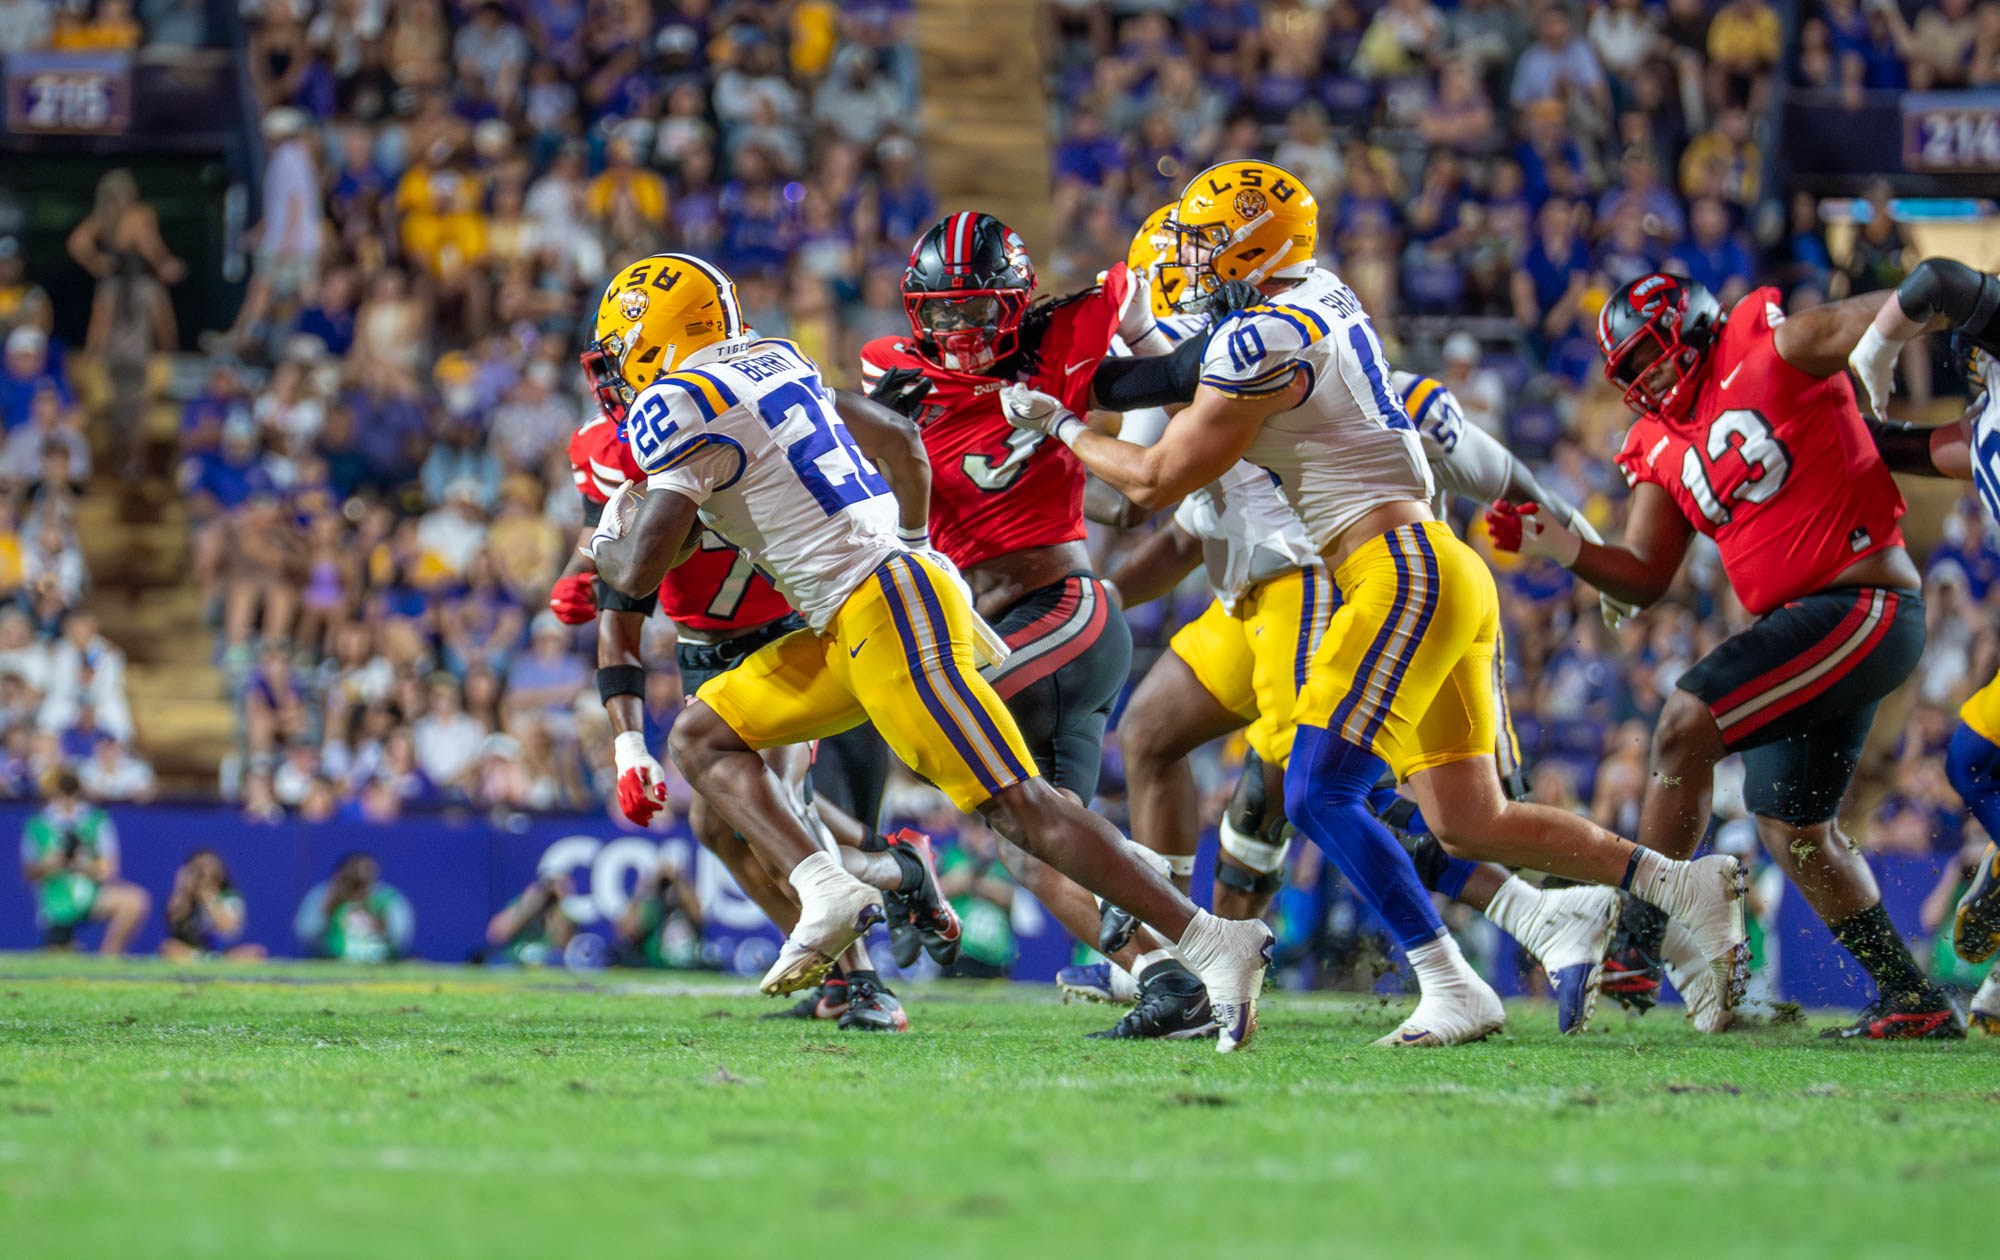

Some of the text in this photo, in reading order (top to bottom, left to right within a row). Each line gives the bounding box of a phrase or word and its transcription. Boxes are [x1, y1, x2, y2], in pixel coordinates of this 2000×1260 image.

[1208, 168, 1297, 203] LSU
[606, 264, 683, 304] LSU
[729, 351, 796, 382] BERRY
[1228, 323, 1267, 373] 10
[631, 393, 679, 458] 22
[1680, 408, 1793, 526] 13
